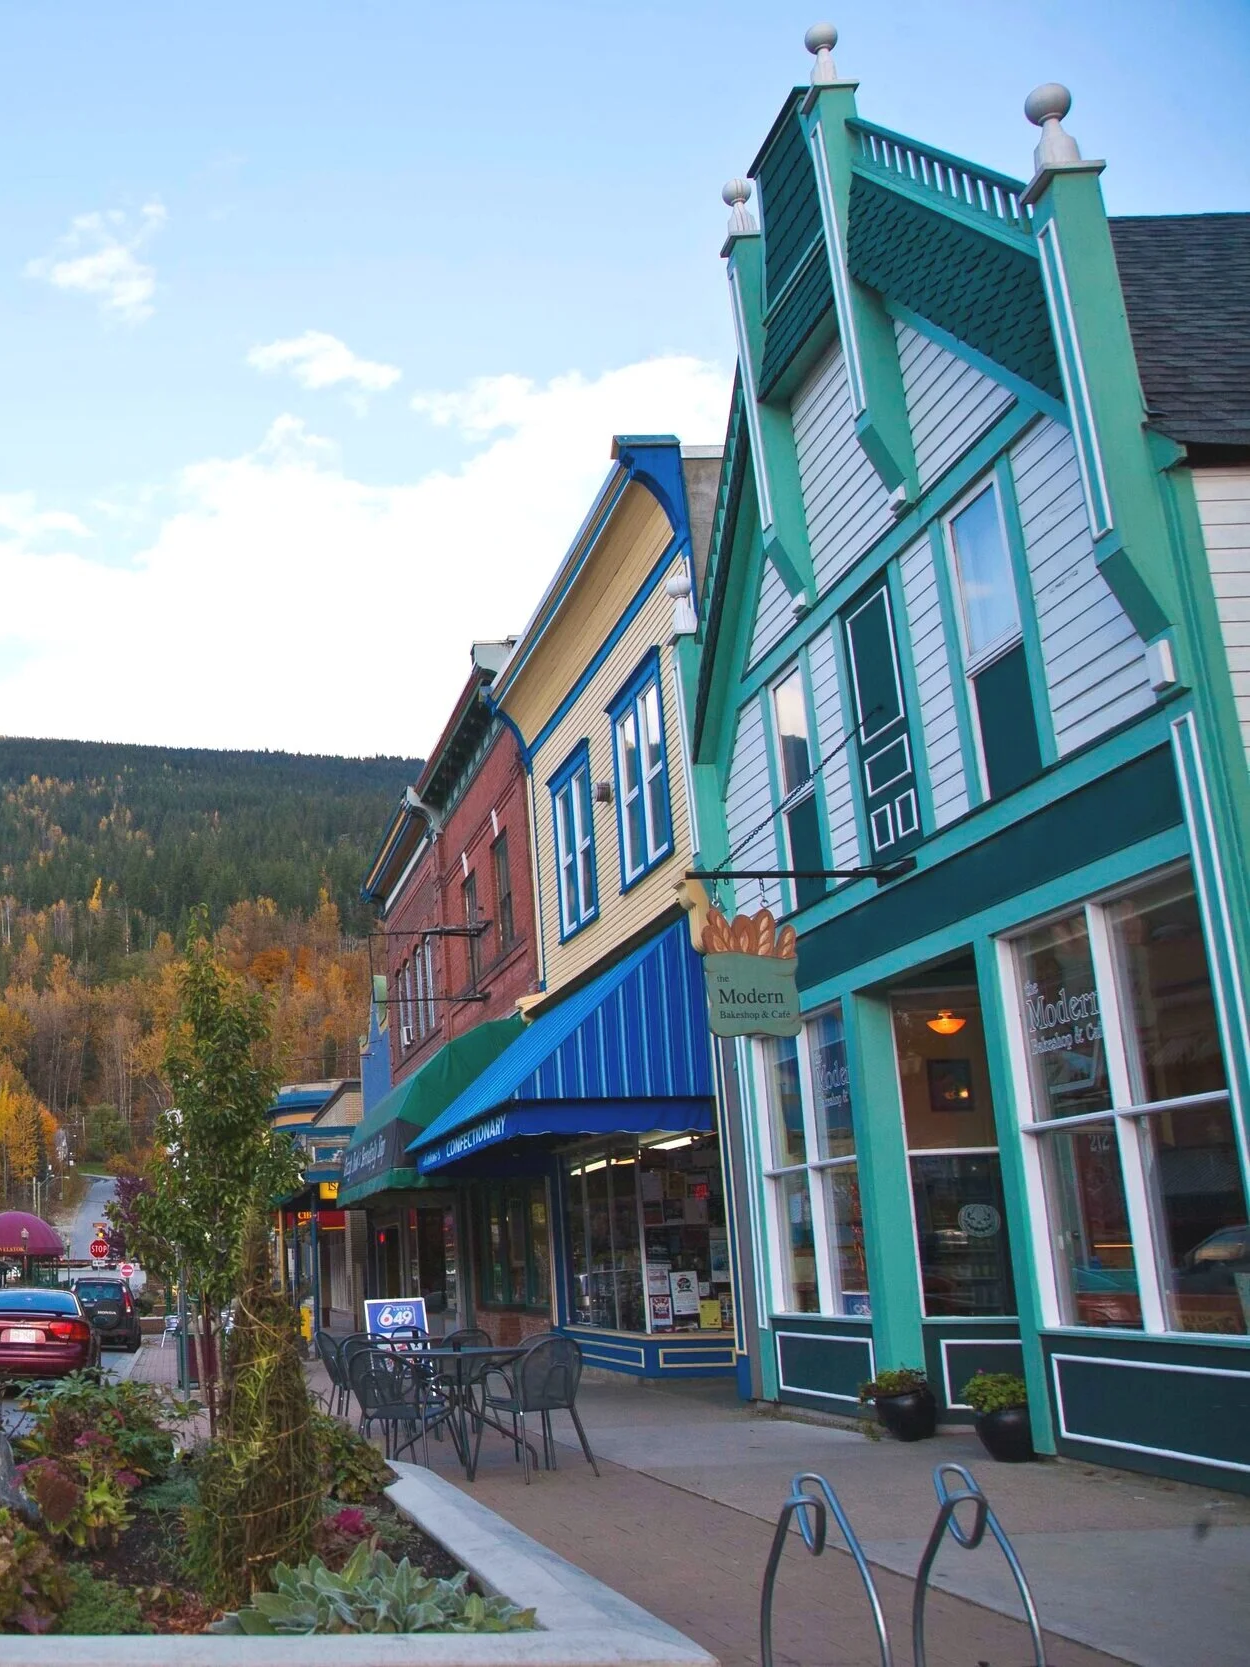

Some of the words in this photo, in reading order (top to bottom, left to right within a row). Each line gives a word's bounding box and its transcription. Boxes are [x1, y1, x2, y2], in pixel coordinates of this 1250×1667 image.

[716, 974, 730, 982] the
[718, 987, 784, 1005] Modern
[720, 1010, 760, 1020] Bakeshop
[761, 1010, 769, 1019] &
[815, 1060, 850, 1093] Mode
[446, 1113, 507, 1158] CONFECTIONARY
[298, 1211, 312, 1220] CIB
[91, 1244, 108, 1254] STOP
